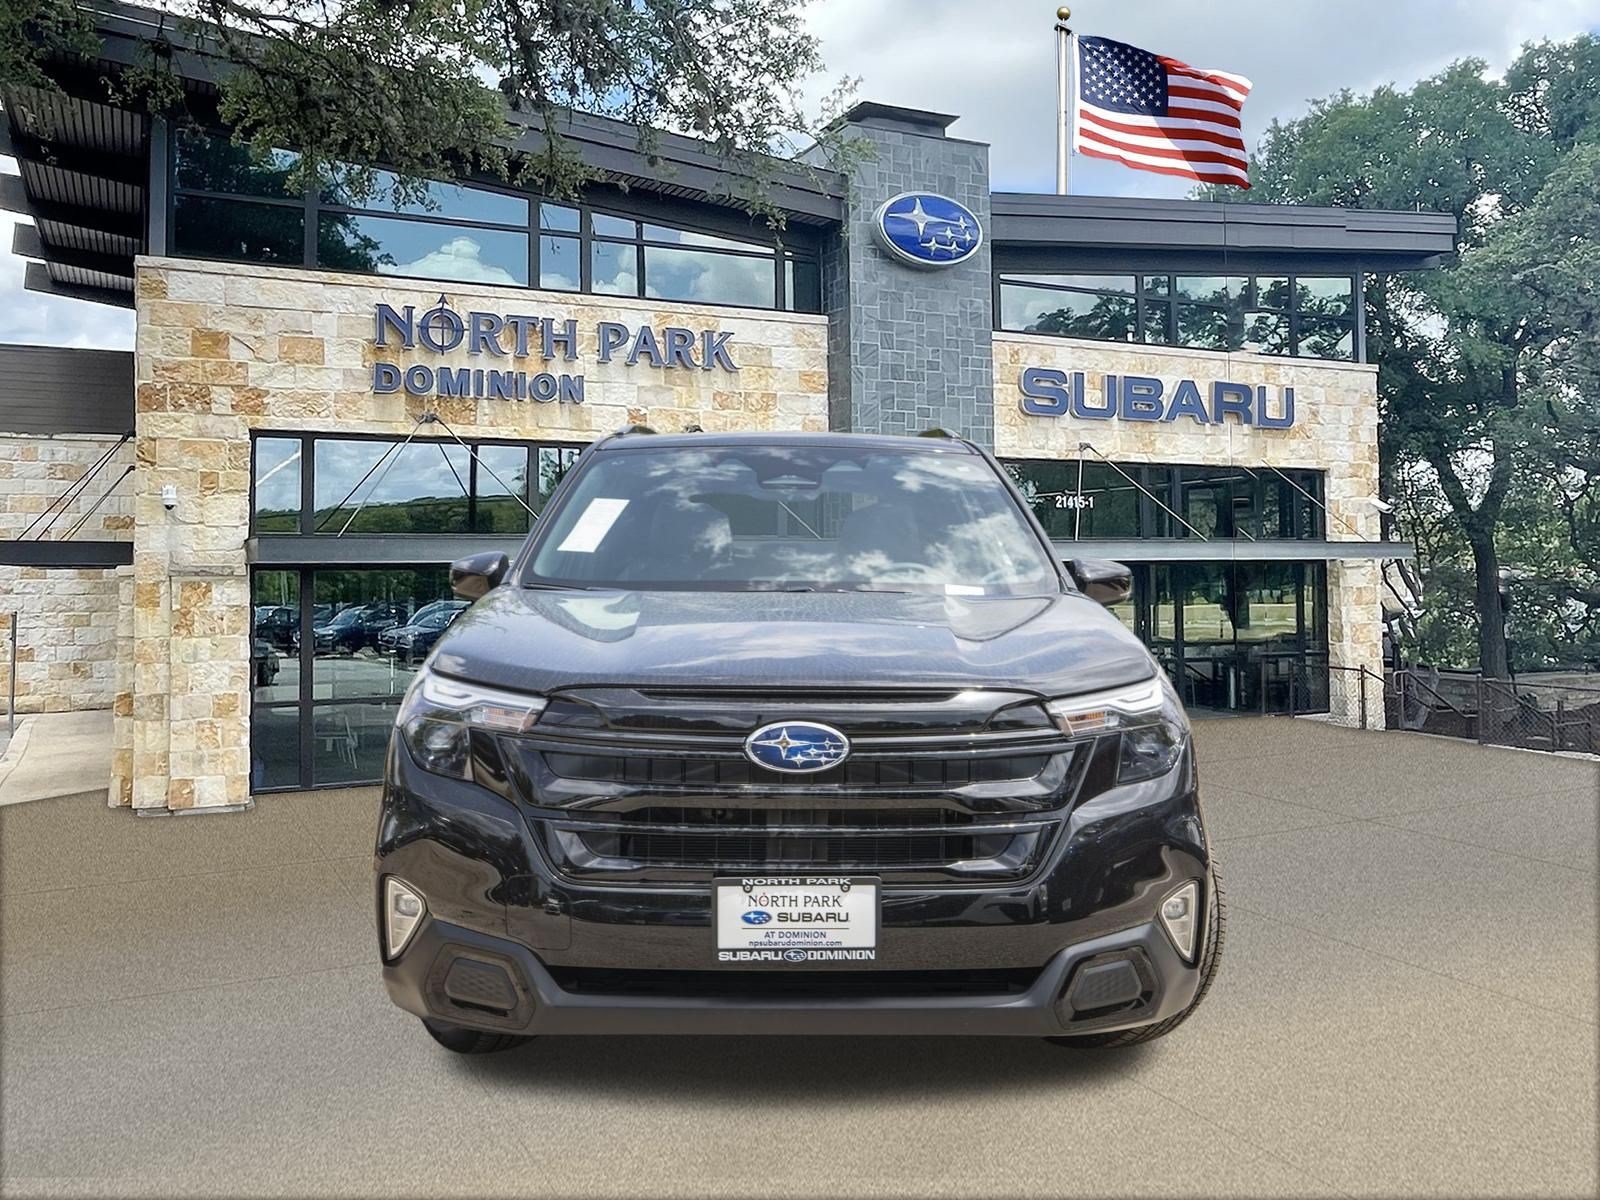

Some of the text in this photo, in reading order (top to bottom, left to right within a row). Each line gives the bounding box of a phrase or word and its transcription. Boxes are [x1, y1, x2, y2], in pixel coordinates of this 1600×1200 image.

[375, 293, 742, 372] NORTH PARK
[373, 362, 585, 404] DOMINION
[1019, 367, 1295, 430] SUBARU
[742, 878, 800, 886] NORTH
[748, 893, 843, 908] NORTH PARK
[777, 912, 849, 923] SUBARU
[764, 931, 827, 939] AT DOMINION
[718, 950, 875, 961] SUBARU DOMINION
